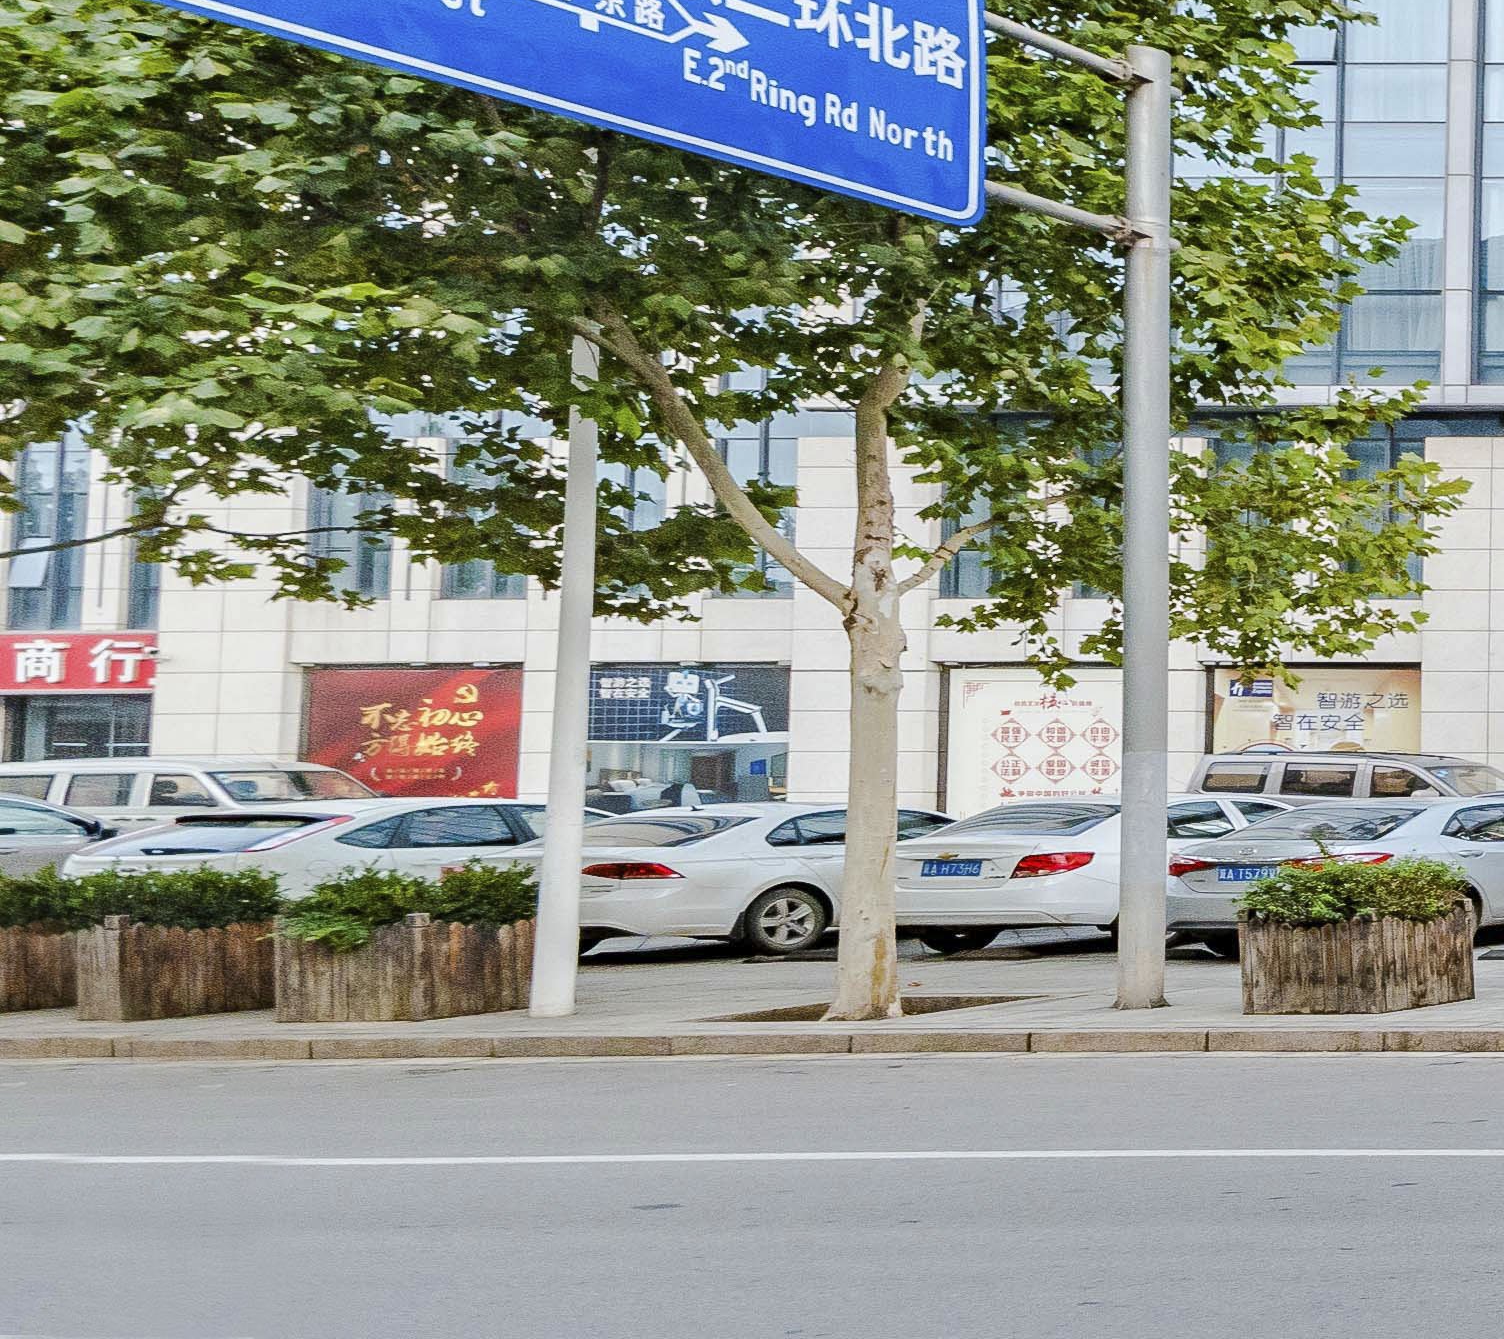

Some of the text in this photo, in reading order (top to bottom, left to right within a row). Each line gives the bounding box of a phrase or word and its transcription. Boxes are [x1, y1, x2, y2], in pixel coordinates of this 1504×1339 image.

[750, 71, 817, 127] Ring
[824, 92, 859, 132] Rd
[868, 106, 955, 162] North
[12, 638, 146, 684] 商行
[359, 698, 485, 732] 不忘初心
[1316, 691, 1409, 709] 智游之选
[1271, 713, 1366, 731] 智在安全
[360, 730, 481, 757] 方得始终
